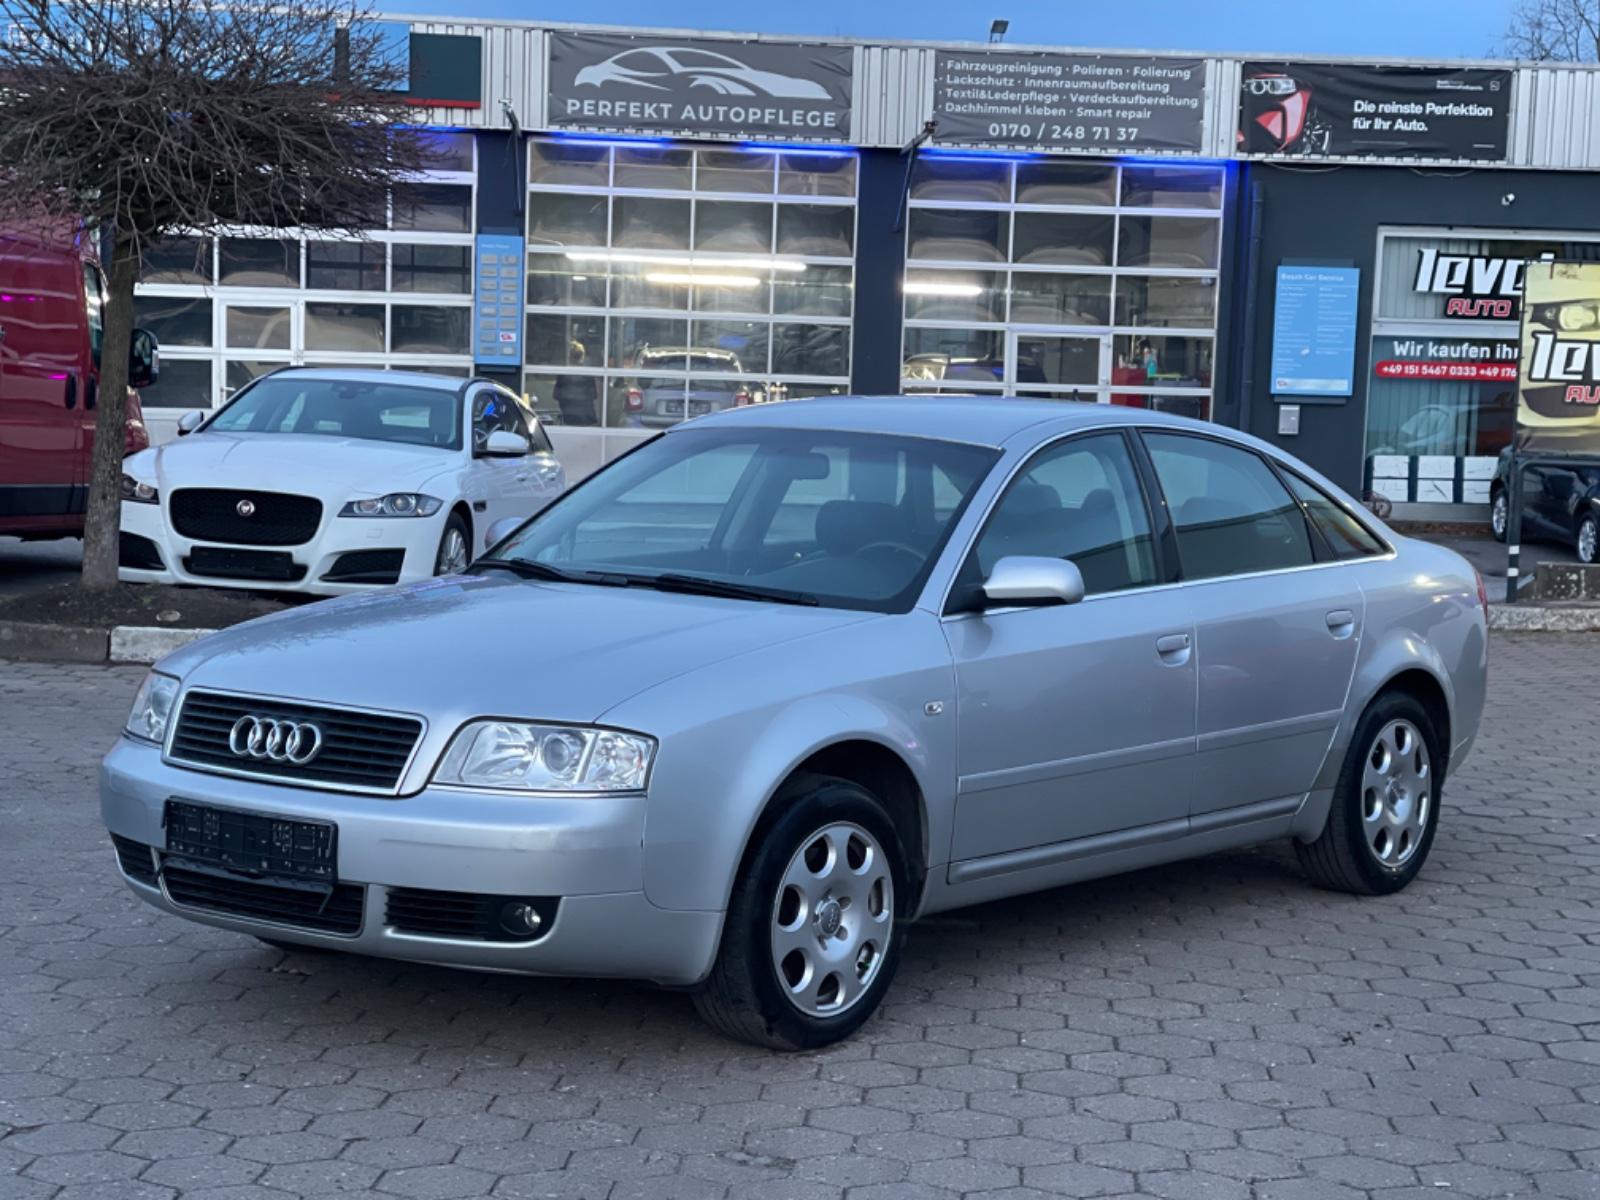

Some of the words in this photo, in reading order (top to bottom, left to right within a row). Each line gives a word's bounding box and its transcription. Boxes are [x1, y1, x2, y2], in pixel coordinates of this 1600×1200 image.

[947, 60, 1062, 76] Fahrzeugreinigung
[1072, 64, 1123, 76] Polieren
[1132, 66, 1191, 80] Folierung
[946, 76, 1015, 87] Lackschutz
[1024, 77, 1169, 93] Innenraumaufbereitung
[945, 88, 1060, 103] Textil&Lederpflege
[1069, 92, 1198, 109] Verdeckaufbereitung
[566, 98, 673, 120] PERFEKT
[680, 104, 837, 128] AUTOPFLEGE
[945, 102, 1022, 115] Dachhimmel
[1025, 104, 1066, 117] kleben
[1076, 106, 1113, 118] Smart
[1115, 106, 1152, 120] repair
[1353, 99, 1375, 113] Die
[1378, 101, 1423, 115] reinste
[1425, 101, 1493, 117] Perfektion
[988, 122, 1031, 138] 0170
[1051, 124, 1085, 140] 248
[1093, 125, 1110, 141] 71
[1116, 126, 1139, 141] 37
[1352, 117, 1371, 130] für
[1373, 117, 1392, 131] Ihr
[1394, 118, 1428, 132] Auto.
[1447, 298, 1512, 317] AUTO
[1393, 341, 1423, 357] Wir
[1428, 341, 1491, 358] kaufen
[1382, 364, 1402, 374] +49
[1404, 364, 1419, 374] 151
[1421, 365, 1447, 375] 5467
[1449, 365, 1477, 376] 0333
[1479, 367, 1499, 377] +49
